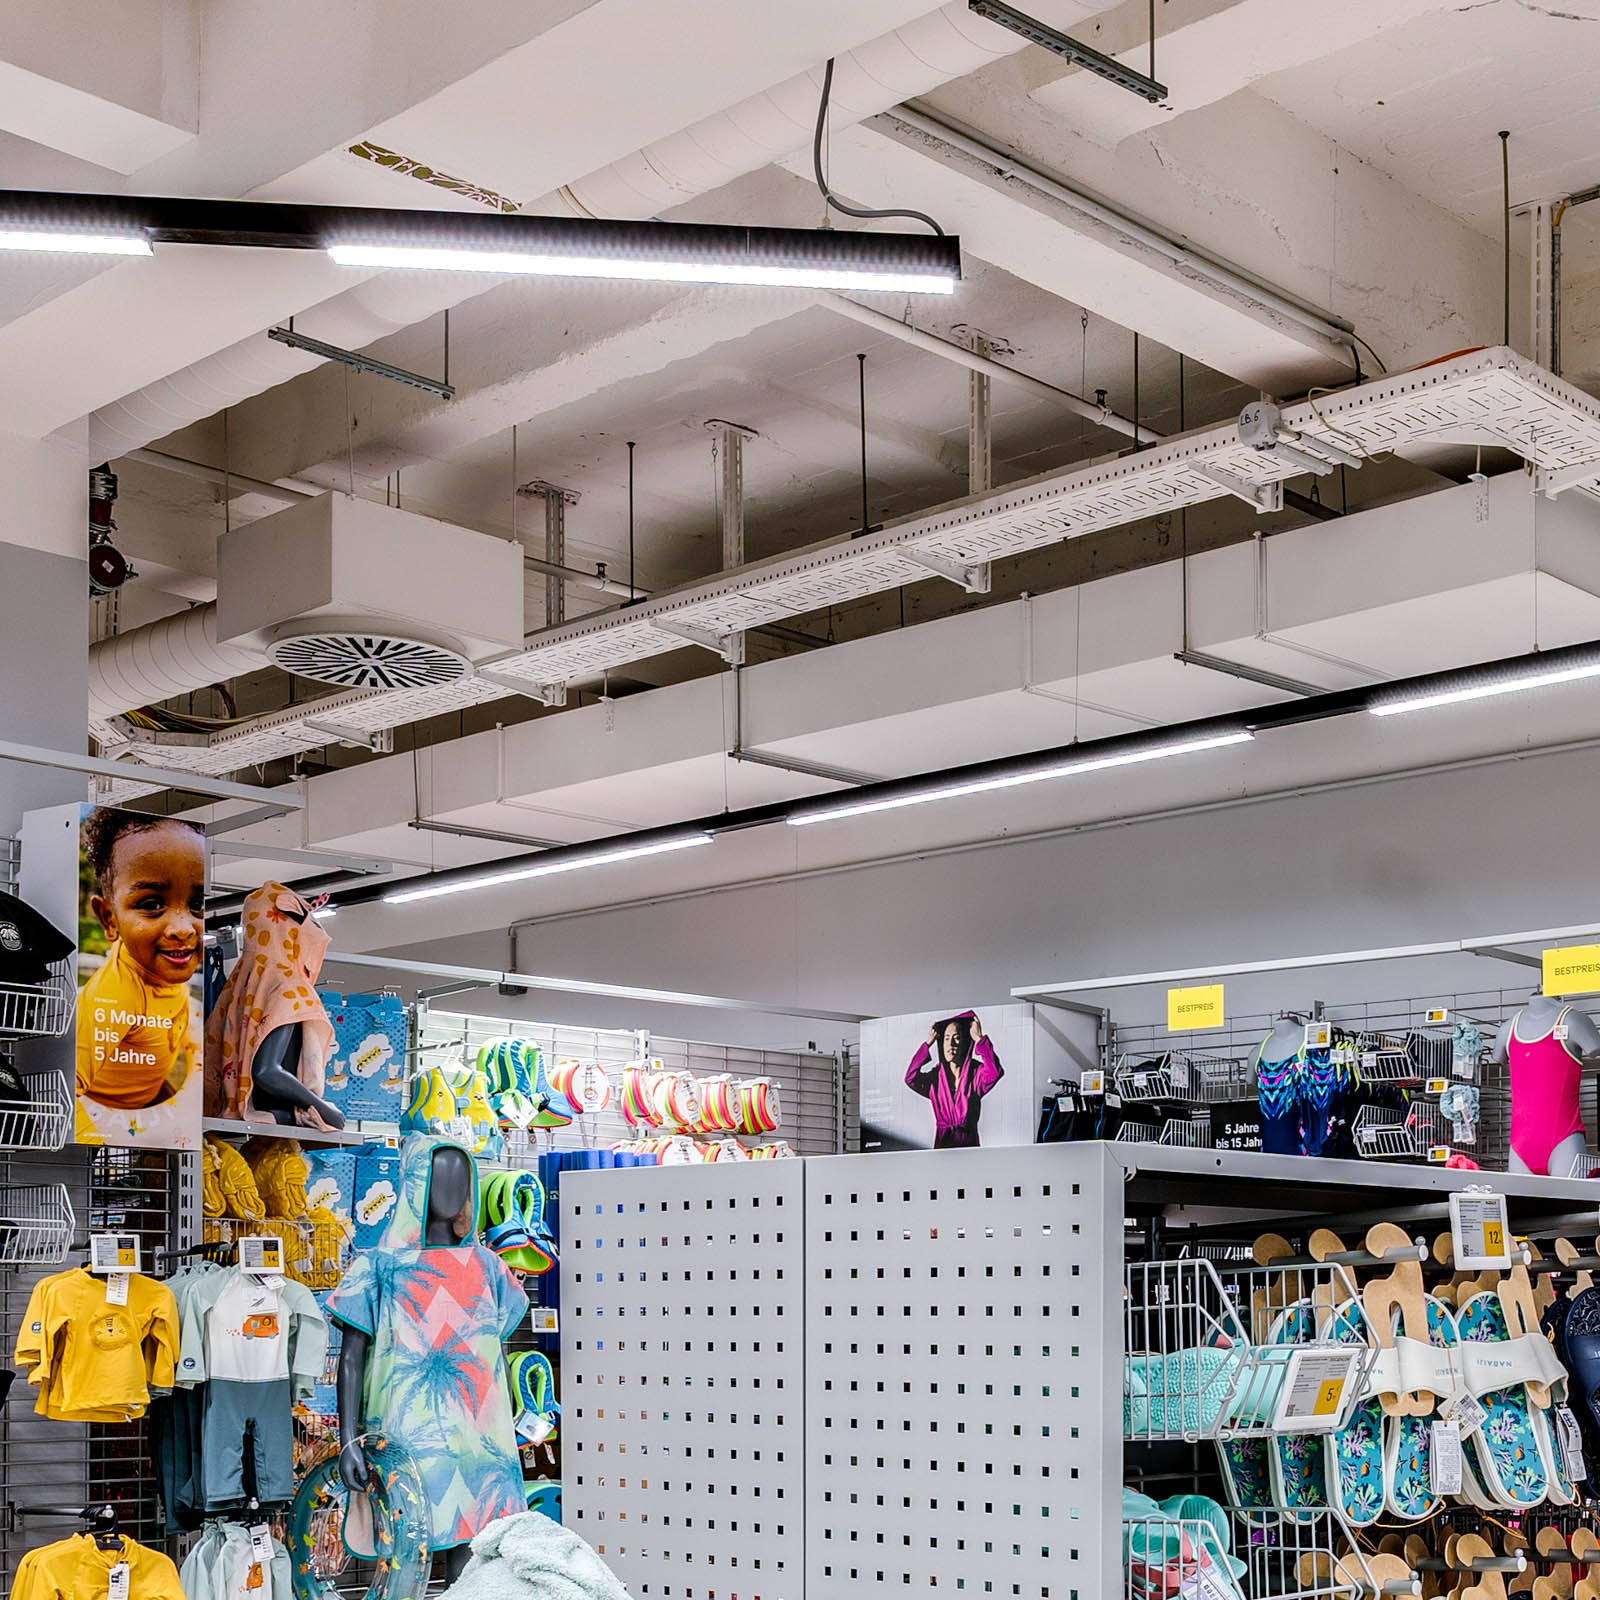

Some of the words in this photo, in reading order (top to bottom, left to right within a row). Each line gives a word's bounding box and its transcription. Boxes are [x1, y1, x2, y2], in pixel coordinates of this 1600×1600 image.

[1554, 963, 1600, 976] BESTPREIS
[1177, 1002, 1214, 1013] BESTPREIS
[94, 1008, 105, 1023] 6
[110, 1009, 173, 1029] Monate
[94, 1027, 119, 1043] bis
[94, 1046, 106, 1061] 5
[109, 1048, 156, 1065] Jahre
[1224, 1123, 1232, 1134] 5
[1233, 1122, 1260, 1134] Jahre
[1215, 1138, 1230, 1149] bis
[1230, 1137, 1242, 1148] 15
